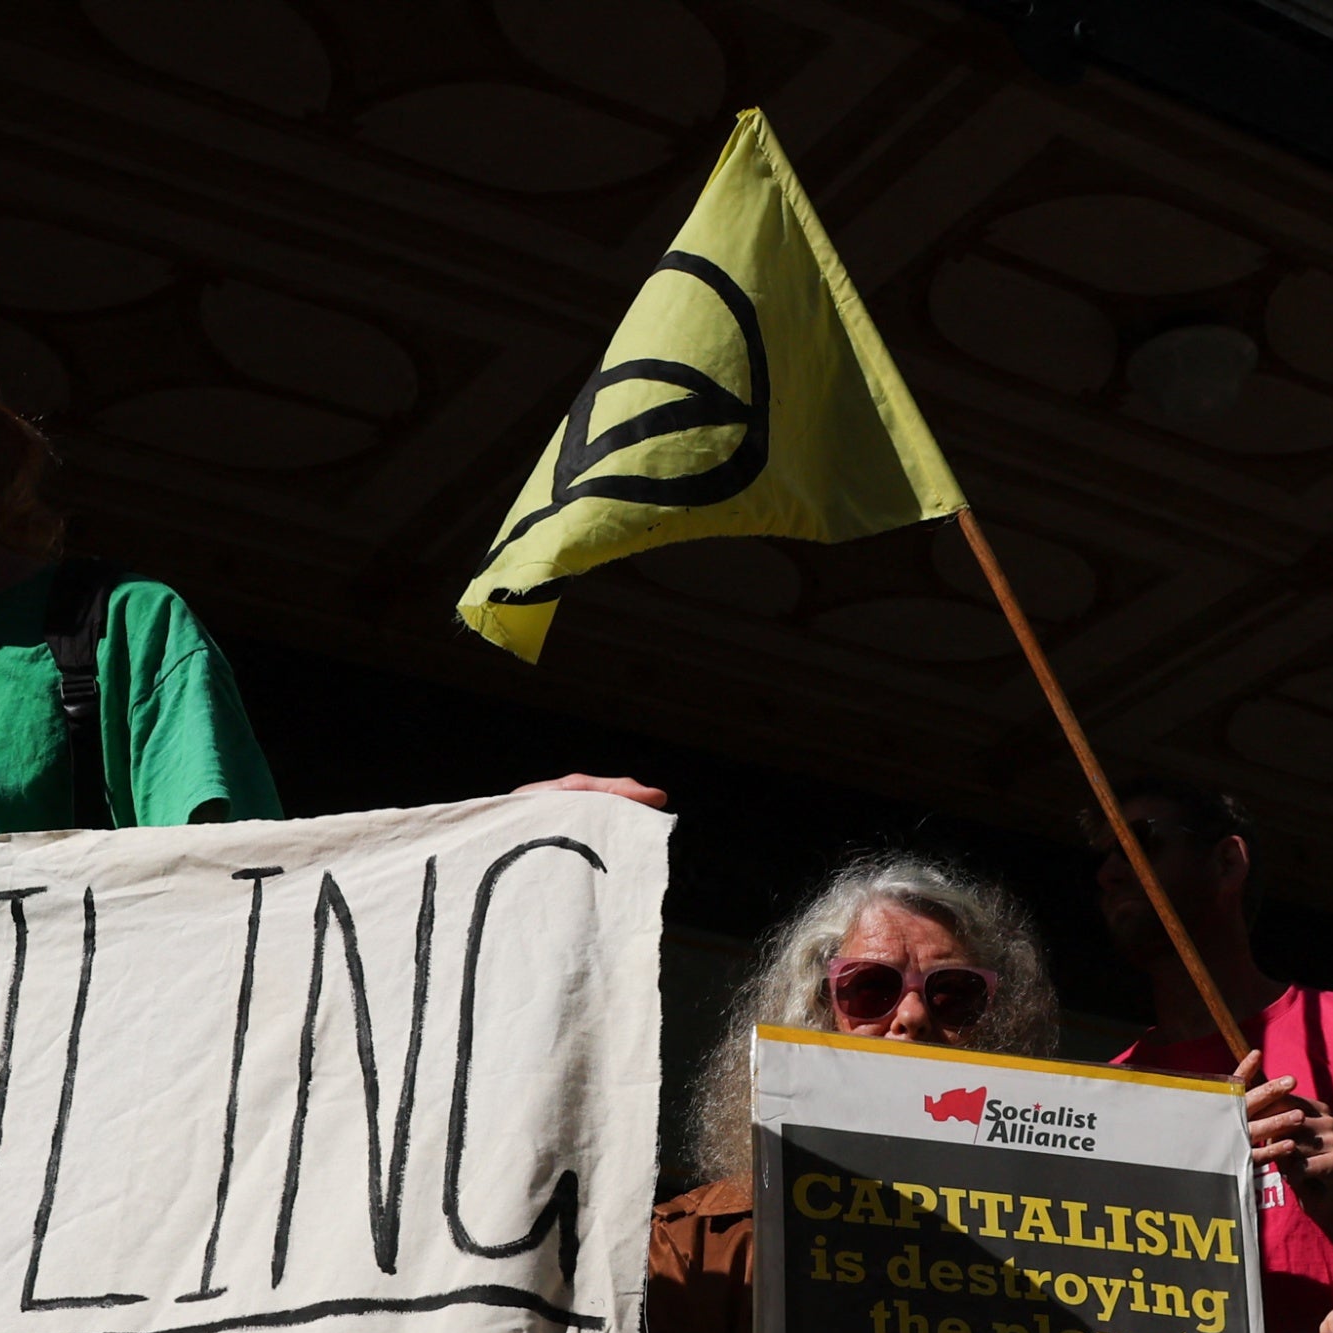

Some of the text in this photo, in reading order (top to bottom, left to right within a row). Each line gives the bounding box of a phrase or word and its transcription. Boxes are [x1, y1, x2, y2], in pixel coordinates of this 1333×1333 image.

[984, 1098, 1098, 1131] Socialist
[986, 1119, 1097, 1153] Alliance
[792, 1172, 1241, 1266] CAPITALISM
[809, 1234, 867, 1284] is
